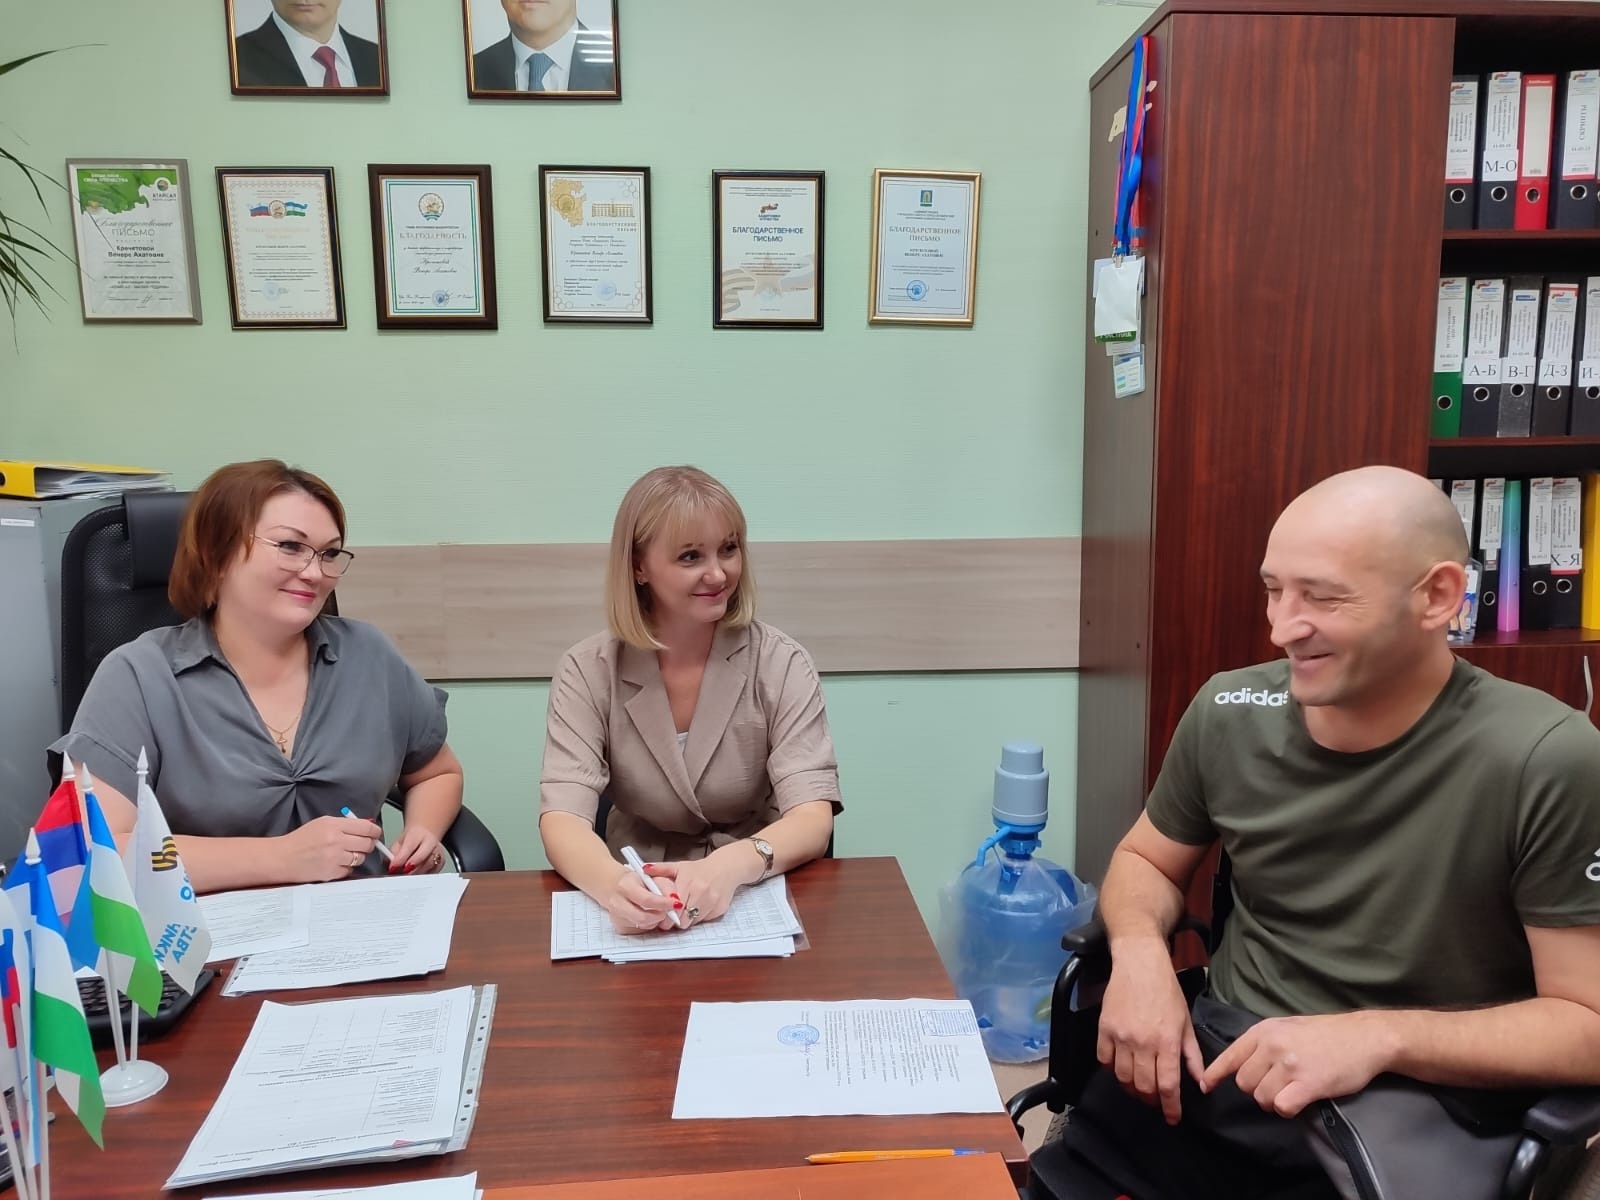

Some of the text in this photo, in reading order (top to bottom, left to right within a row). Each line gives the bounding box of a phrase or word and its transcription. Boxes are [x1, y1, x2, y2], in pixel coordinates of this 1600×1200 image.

[1484, 159, 1517, 173] М-О
[111, 228, 156, 236] ПИСЬМО
[732, 226, 804, 234] БЛАГОДАРСТВЕННОЕ
[909, 234, 941, 242] ПИСЬМО
[1469, 364, 1497, 377] А-Б
[1508, 365, 1535, 378] В-Г
[1544, 364, 1568, 377] Д-З
[1582, 367, 1600, 379] И-
